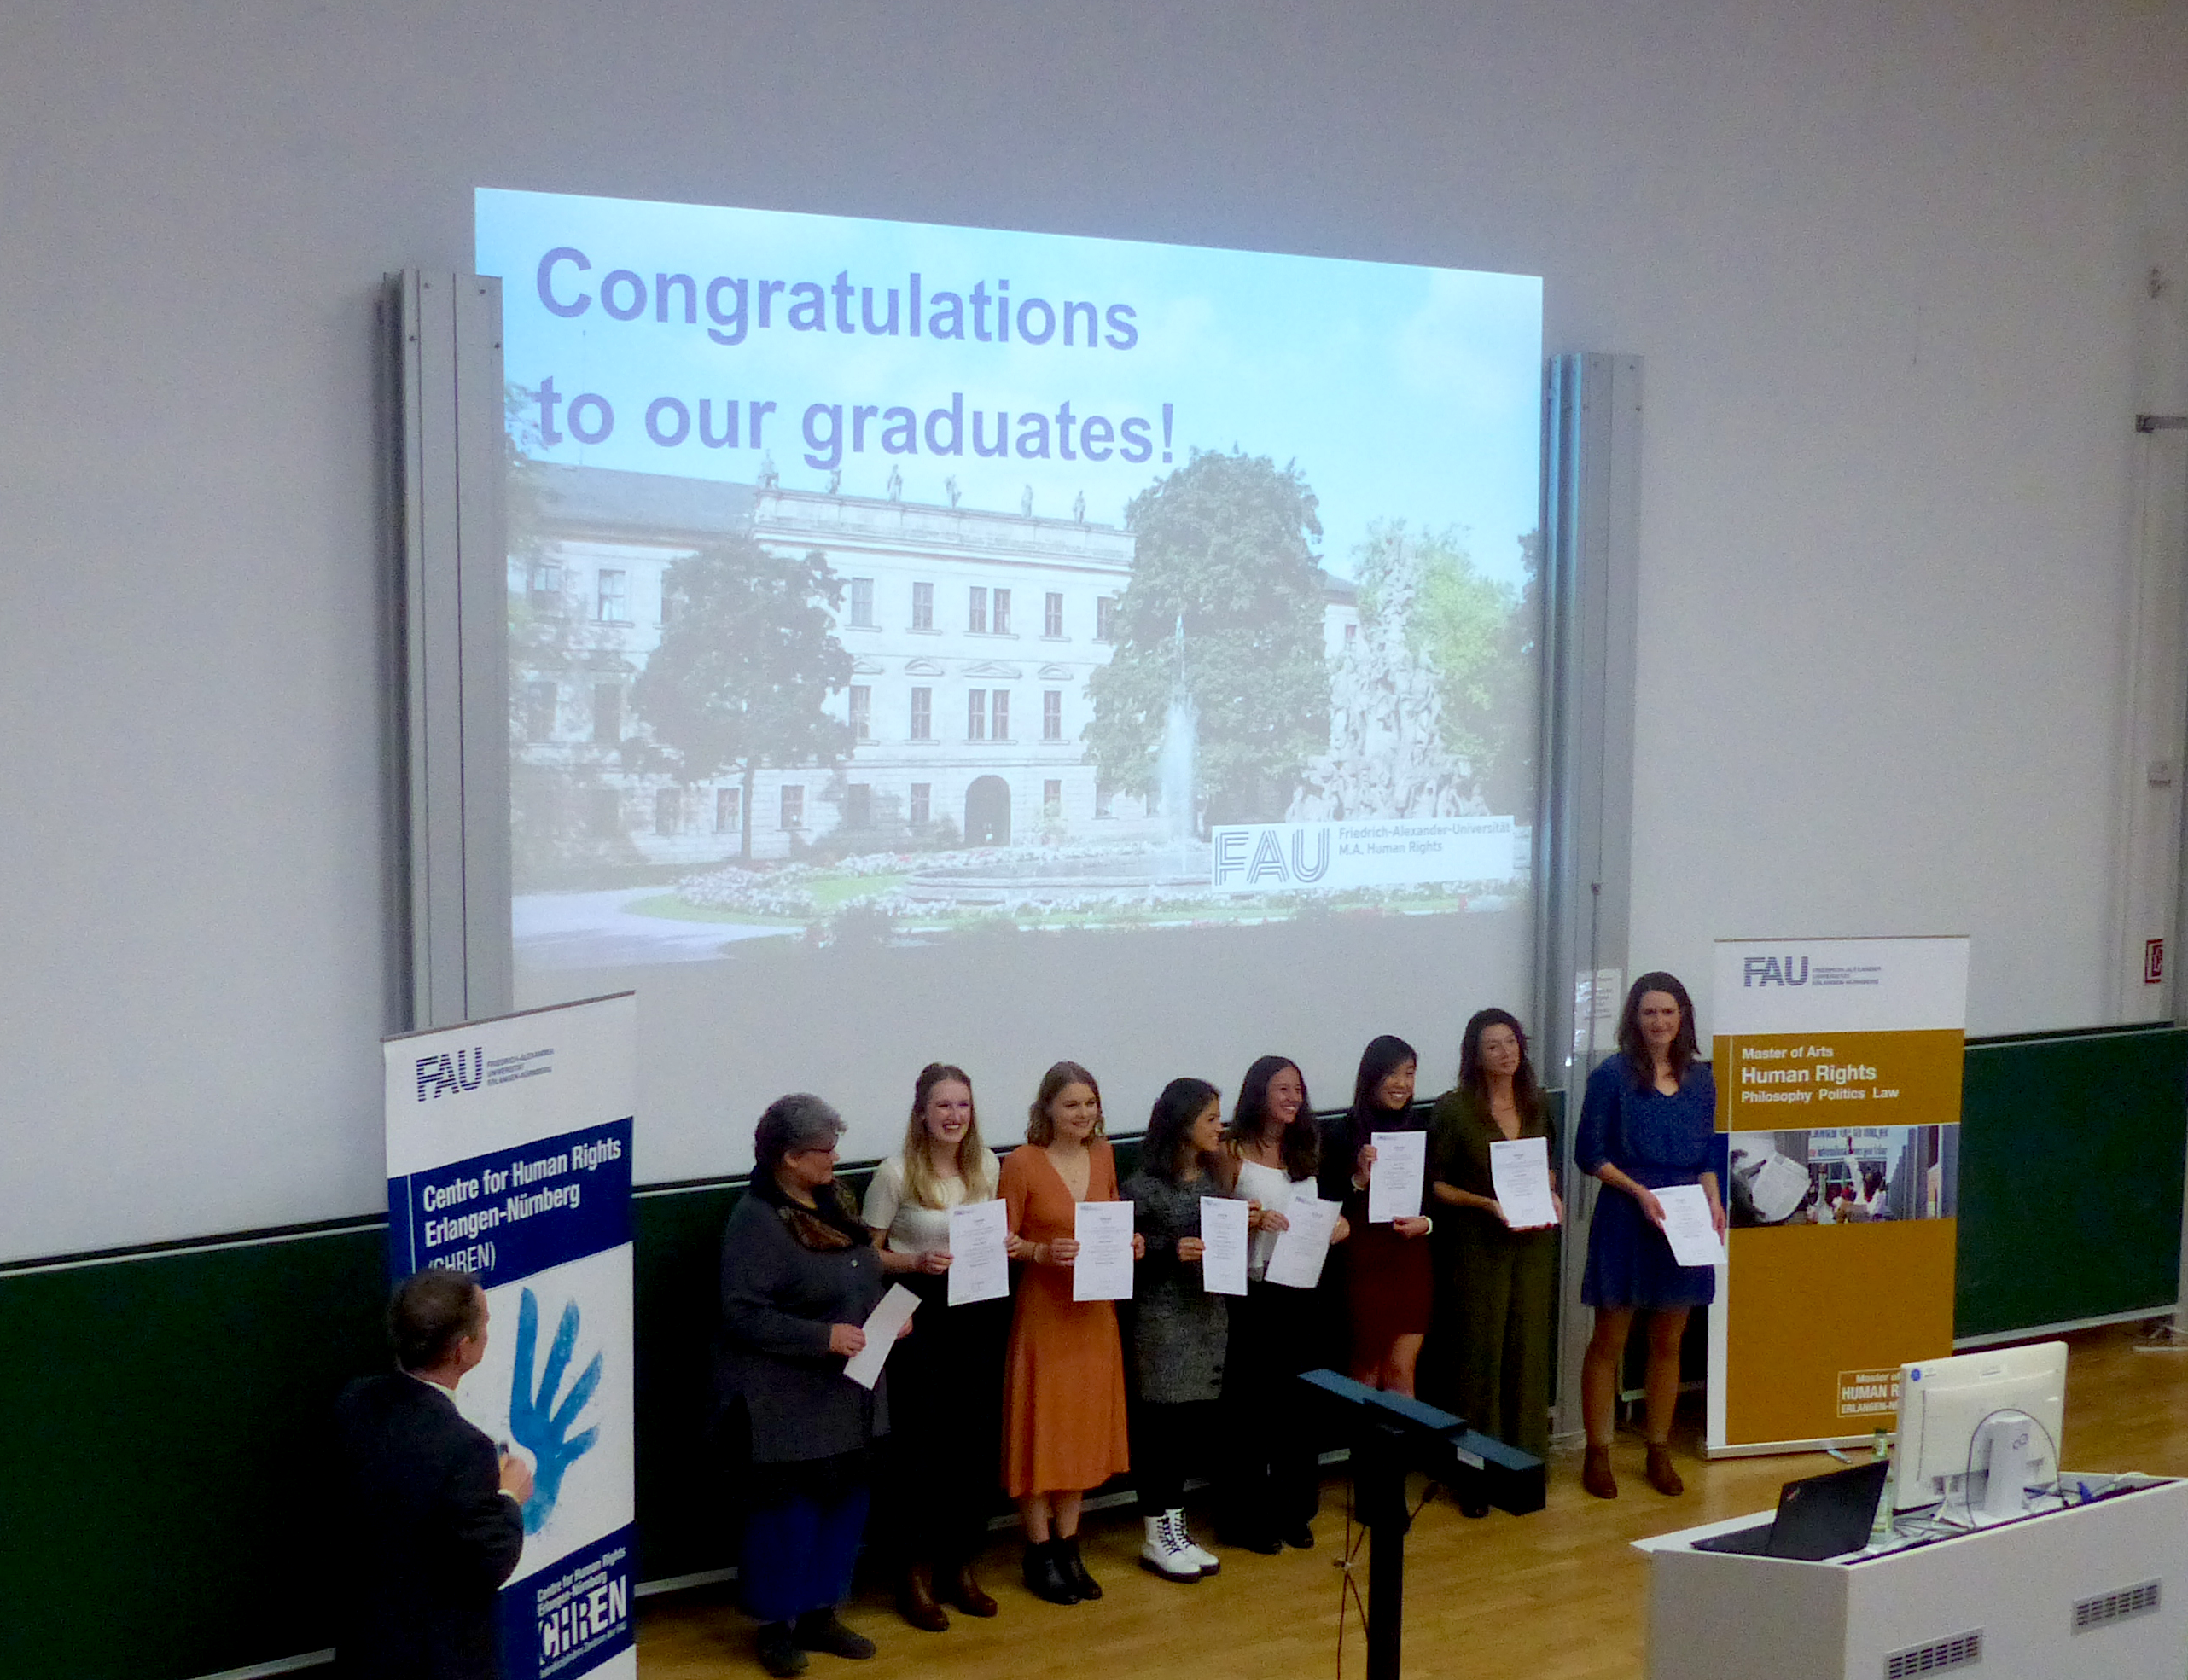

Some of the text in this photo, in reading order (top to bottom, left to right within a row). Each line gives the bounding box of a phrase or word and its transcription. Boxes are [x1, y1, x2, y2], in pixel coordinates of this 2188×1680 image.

[536, 246, 1138, 350] Congratulations
[535, 375, 1174, 470] to our graduates!
[1338, 823, 1511, 840] Friedrich-Alexander-Universität
[1215, 828, 1330, 886] FAU
[1367, 843, 1406, 855] Human
[1408, 841, 1443, 854] Rights
[1743, 956, 1808, 986] FAU
[1742, 1046, 1834, 1060] Master of Arts
[416, 1046, 483, 1102] FAU
[1741, 1065, 1877, 1085] Human Rights
[1741, 1087, 1900, 1103] Philosophy Politics Law
[423, 1137, 622, 1212] Centre for Human Rights
[424, 1183, 580, 1248] Erlangen-Nürnberg
[1842, 1385, 1887, 1400] HUMAN
